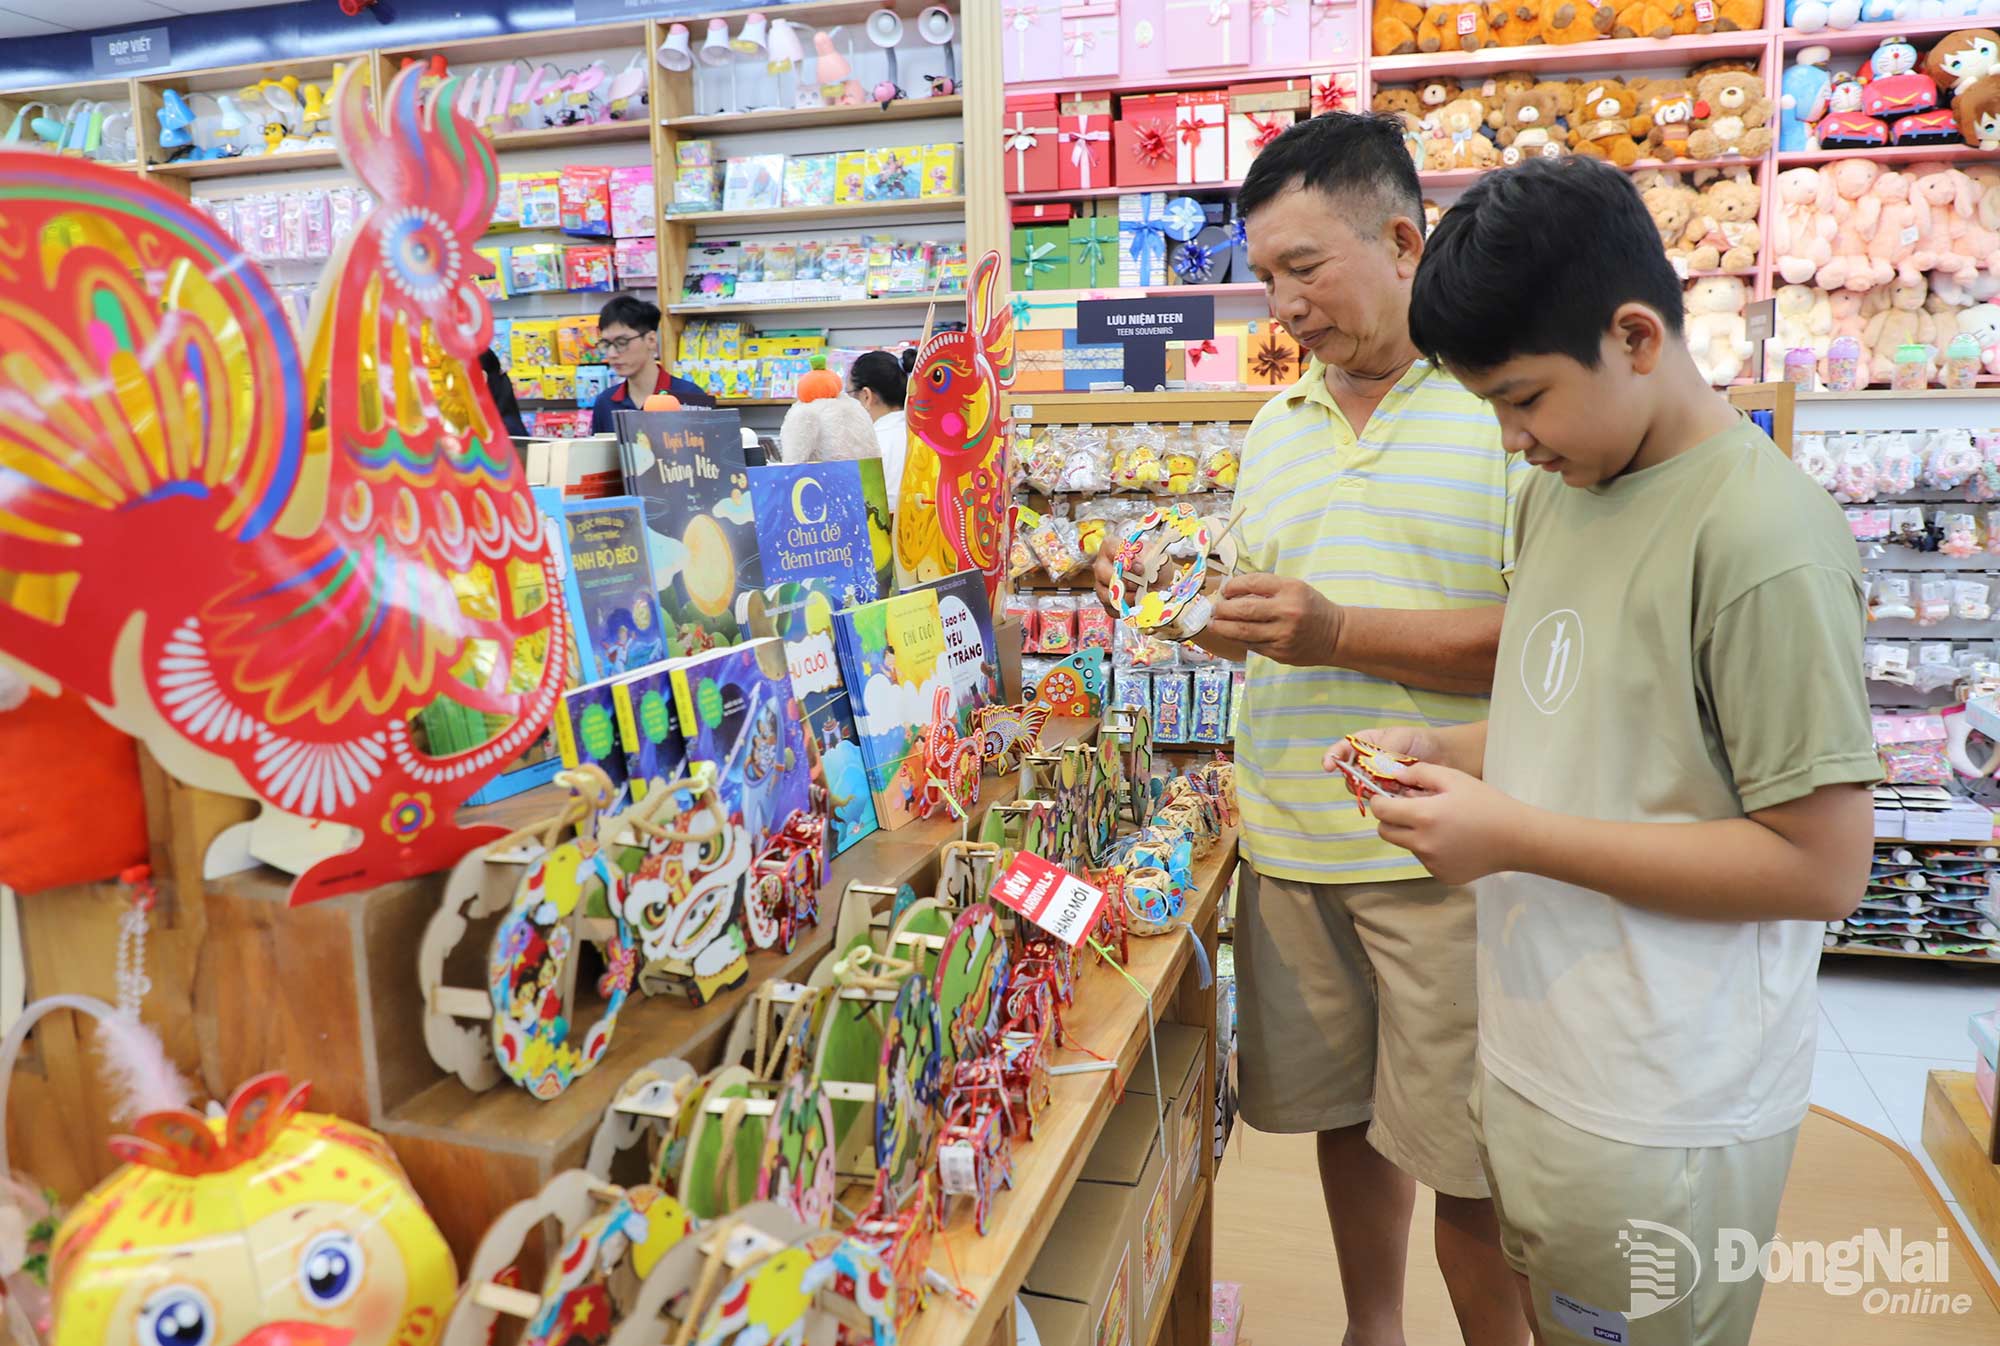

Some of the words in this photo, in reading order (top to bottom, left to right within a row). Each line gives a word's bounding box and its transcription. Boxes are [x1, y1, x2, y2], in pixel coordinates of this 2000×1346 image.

[1106, 314, 1126, 326] LƯU
[1128, 312, 1155, 327] NIỆM
[1157, 313, 1183, 324] TEEN
[1116, 328, 1134, 336] TEEN
[1135, 326, 1174, 336] SOUVENIRS
[657, 458, 694, 488] Trăng
[787, 526, 818, 548] Chú
[820, 523, 841, 543] dế
[814, 542, 854, 568] trăng
[945, 615, 958, 628] sao
[946, 629, 963, 648] YÊU
[1003, 869, 1032, 900] NEW
[1053, 908, 1078, 936] HÀNG
[1070, 887, 1091, 912] MỚI
[1595, 1329, 1619, 1341] SPORT
